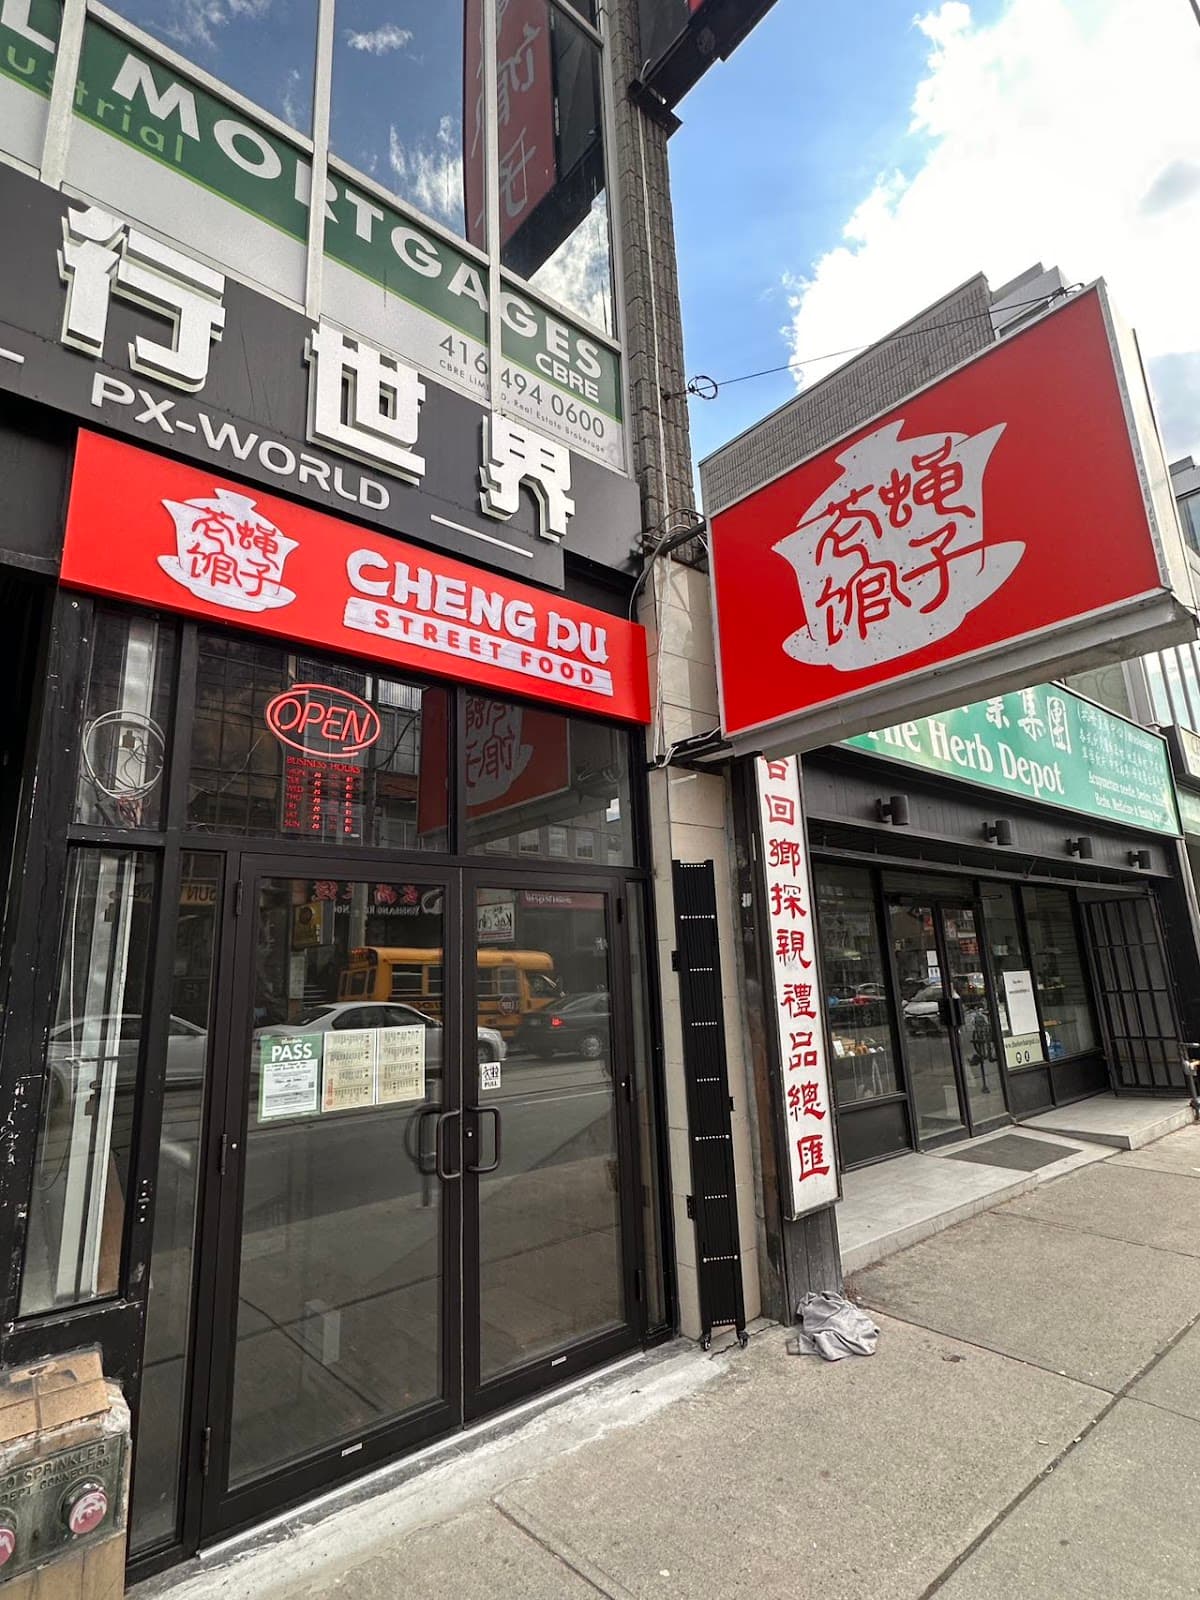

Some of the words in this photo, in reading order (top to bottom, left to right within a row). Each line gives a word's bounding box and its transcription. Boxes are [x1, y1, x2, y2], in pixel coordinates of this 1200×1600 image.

[112, 53, 602, 380] MORTGAGES
[57, 205, 576, 543] 行世界
[439, 335, 489, 376] 416
[500, 367, 544, 406] 494
[551, 394, 605, 440] 0600
[439, 359, 466, 379] CBRE
[536, 410, 562, 431] Estate
[535, 352, 600, 404] CBRE
[91, 372, 390, 512] PX-WORLD
[346, 548, 538, 642] CHENG
[547, 611, 610, 664] DU
[375, 609, 502, 660] STREET
[521, 650, 595, 686] FOOD
[273, 697, 372, 745] OPEN
[927, 717, 994, 774] Herb
[998, 741, 1066, 797] Depot
[271, 1043, 313, 1062] PASS
[23, 1445, 106, 1483] SPRINKLER
[40, 1456, 111, 1490] CONNECTION
